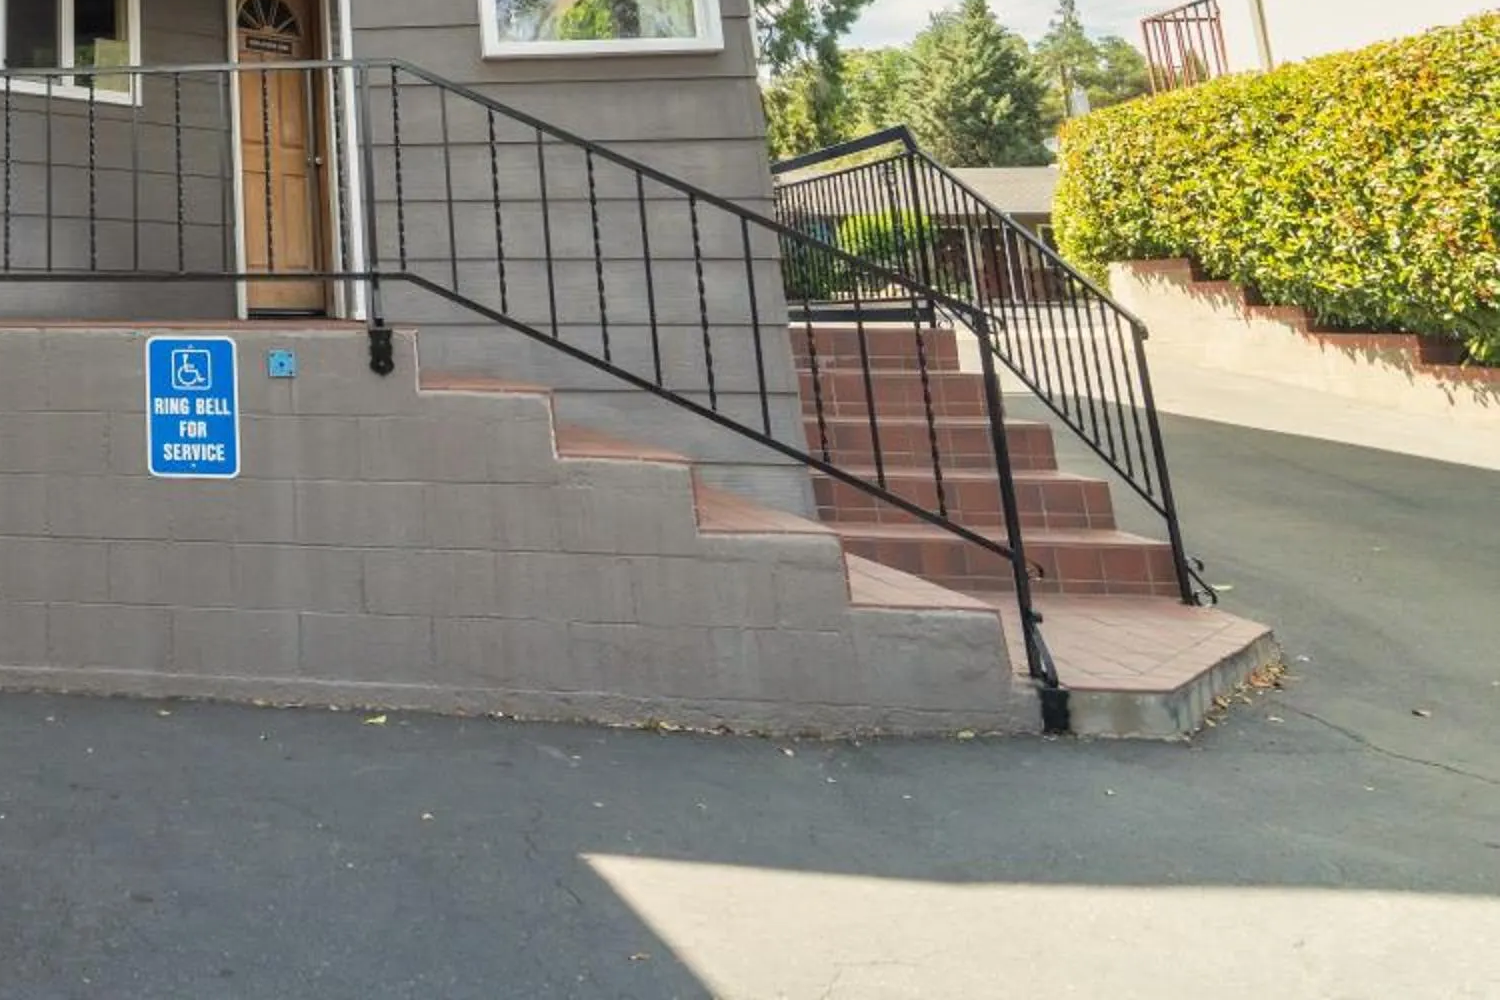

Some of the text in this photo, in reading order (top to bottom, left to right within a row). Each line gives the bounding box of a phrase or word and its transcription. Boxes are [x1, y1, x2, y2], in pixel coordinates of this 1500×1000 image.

[153, 397, 231, 415] RING BELL
[179, 420, 207, 438] FOR
[163, 443, 225, 461] SERVICE
